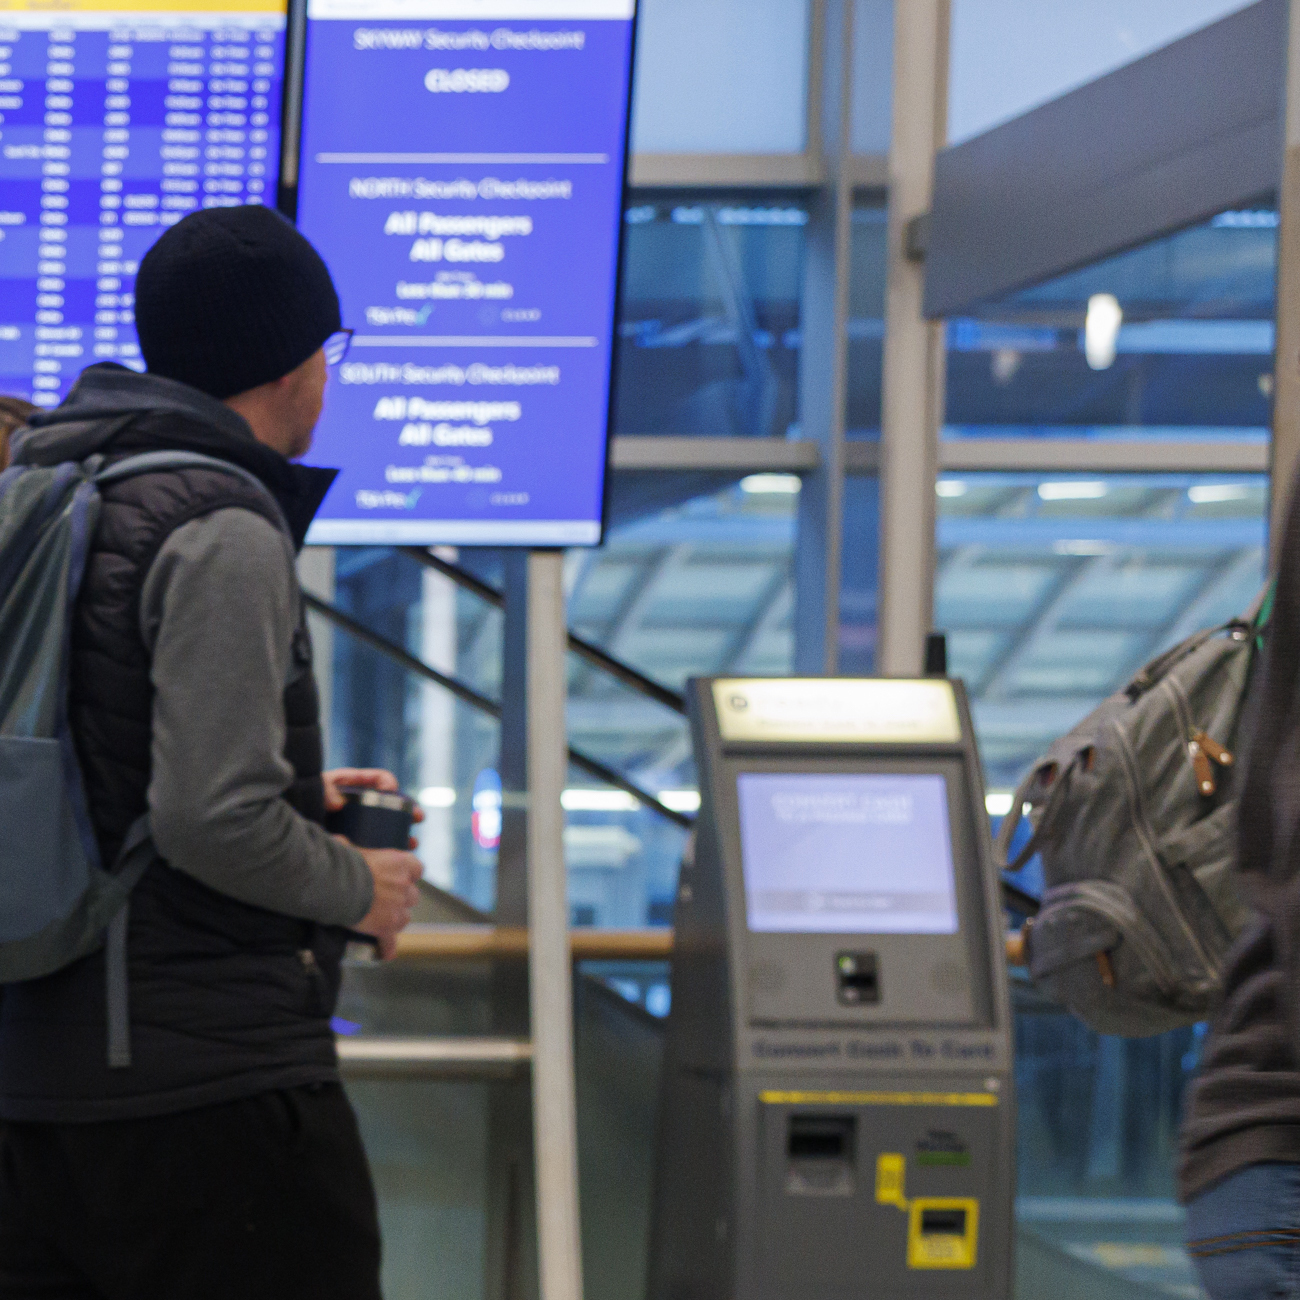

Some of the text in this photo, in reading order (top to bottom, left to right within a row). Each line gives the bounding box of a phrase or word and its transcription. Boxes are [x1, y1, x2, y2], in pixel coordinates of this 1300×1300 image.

[425, 69, 509, 92] CLOSED
[384, 211, 532, 240] All Passengers
[410, 238, 504, 262] All Gates
[374, 396, 521, 425] All Passengers
[399, 423, 492, 446] All Gates
